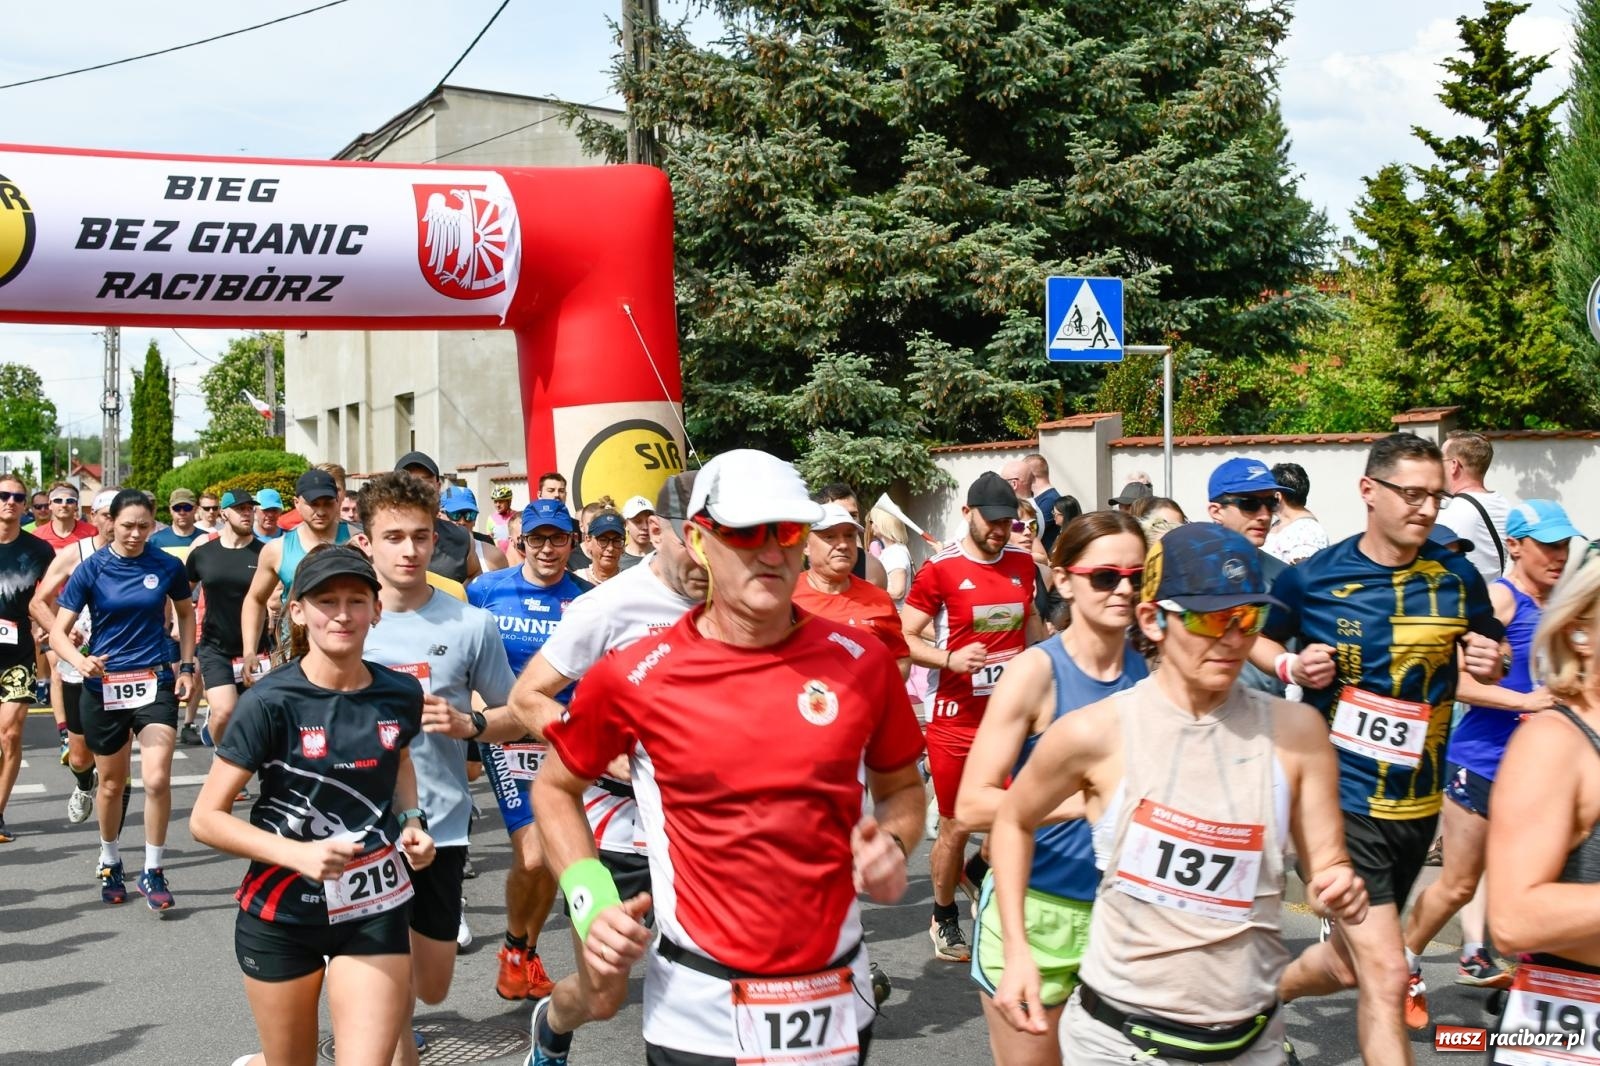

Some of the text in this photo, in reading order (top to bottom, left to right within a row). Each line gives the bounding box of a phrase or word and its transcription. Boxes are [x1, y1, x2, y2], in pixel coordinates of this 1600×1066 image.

[164, 175, 280, 203] BIEG
[75, 217, 369, 255] BEZ GRANIC
[96, 265, 344, 303] RACIBÓRZ
[113, 683, 147, 700] 195
[936, 699, 959, 717] 10
[1356, 711, 1409, 747] 163
[517, 752, 546, 771] 15
[348, 859, 399, 901] 219
[1155, 840, 1237, 892] 137
[764, 1005, 832, 1050] 127
